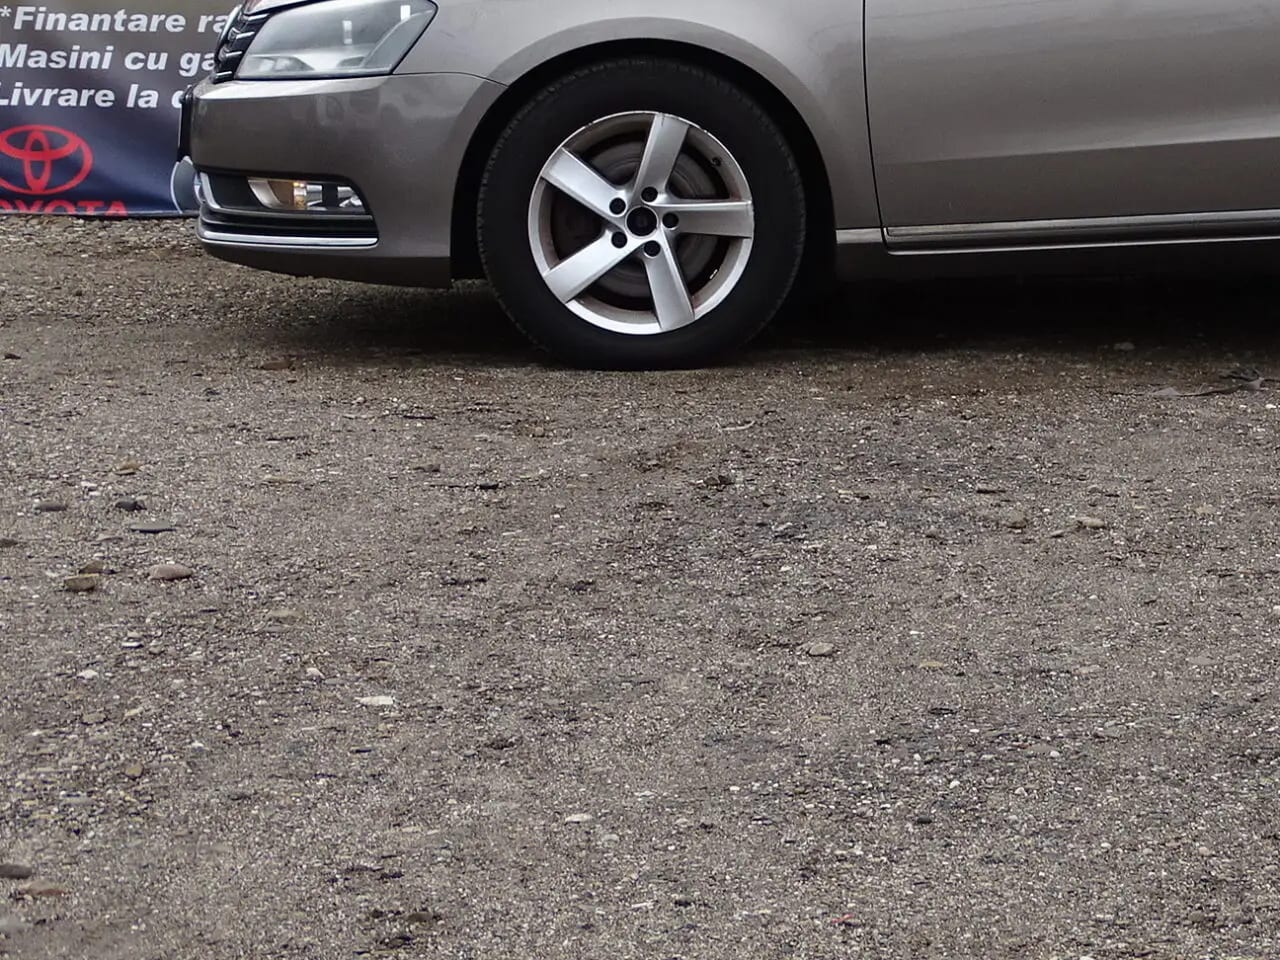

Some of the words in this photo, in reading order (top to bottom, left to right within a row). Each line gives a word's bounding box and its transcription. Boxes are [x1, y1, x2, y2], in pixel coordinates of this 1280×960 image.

[0, 42, 115, 70] Masini
[124, 50, 168, 71] cu
[126, 83, 159, 108] la
